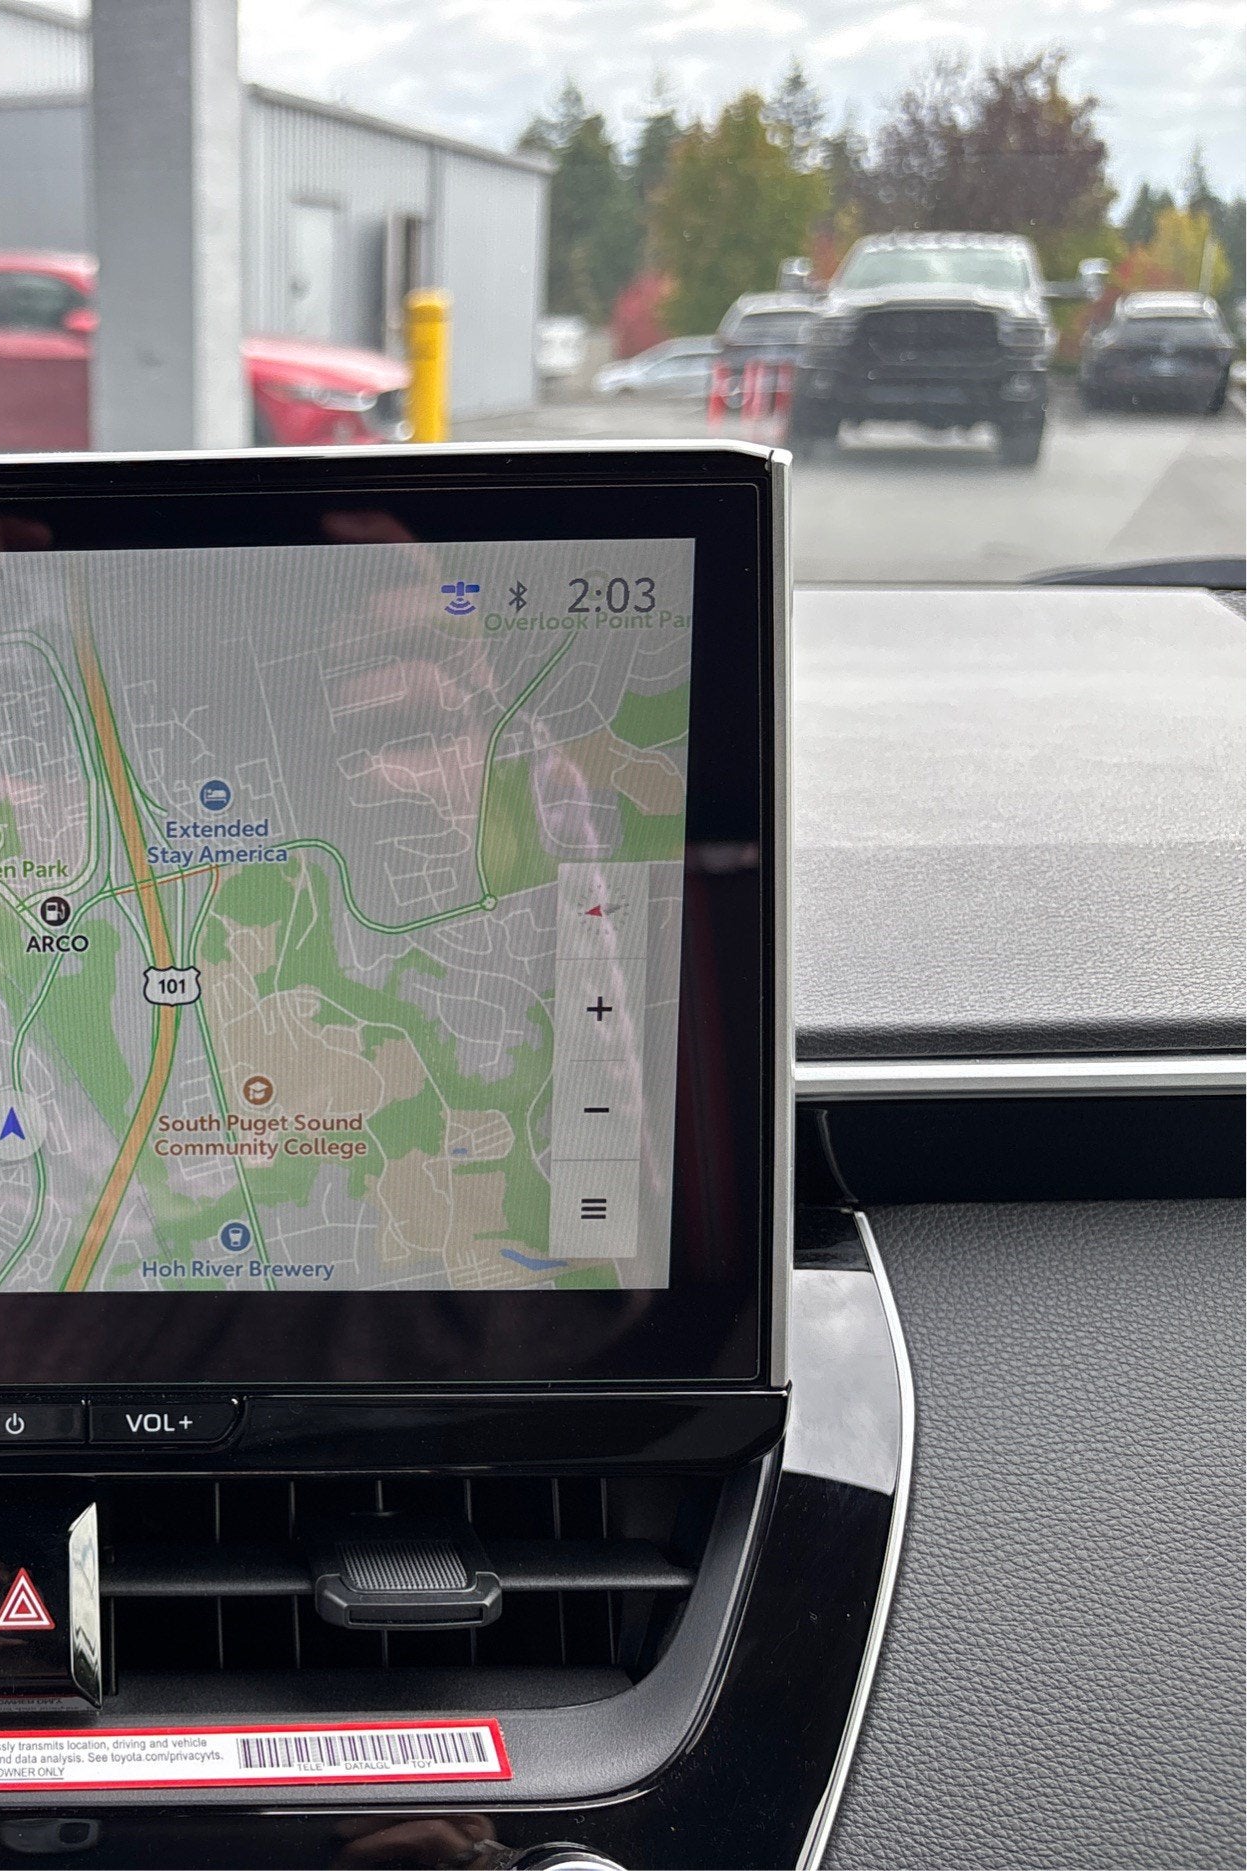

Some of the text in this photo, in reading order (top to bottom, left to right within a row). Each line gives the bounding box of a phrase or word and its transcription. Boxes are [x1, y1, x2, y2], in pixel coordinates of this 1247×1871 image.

[567, 577, 657, 614] 2:03
[484, 610, 589, 631] Overlook
[594, 611, 653, 630] Point
[165, 818, 270, 839] Extended
[146, 844, 288, 868] Stay America
[22, 859, 69, 879] Park
[26, 934, 90, 952] ARCO
[157, 979, 186, 995] 101
[157, 1112, 364, 1136] South Puget Sound
[154, 1137, 368, 1160] Community College
[142, 1259, 336, 1282] Hoh River Brewery
[18, 1740, 65, 1751] transmits
[66, 1740, 110, 1751] location,
[112, 1739, 146, 1751] driving
[149, 1738, 169, 1748] and
[171, 1737, 208, 1748] vehicle
[14, 1753, 37, 1764] data
[40, 1752, 85, 1765] analysis.
[87, 1752, 108, 1763] See
[297, 1763, 323, 1772] TELE
[412, 1760, 432, 1769] TOY
[37, 1766, 65, 1777] ONLY
